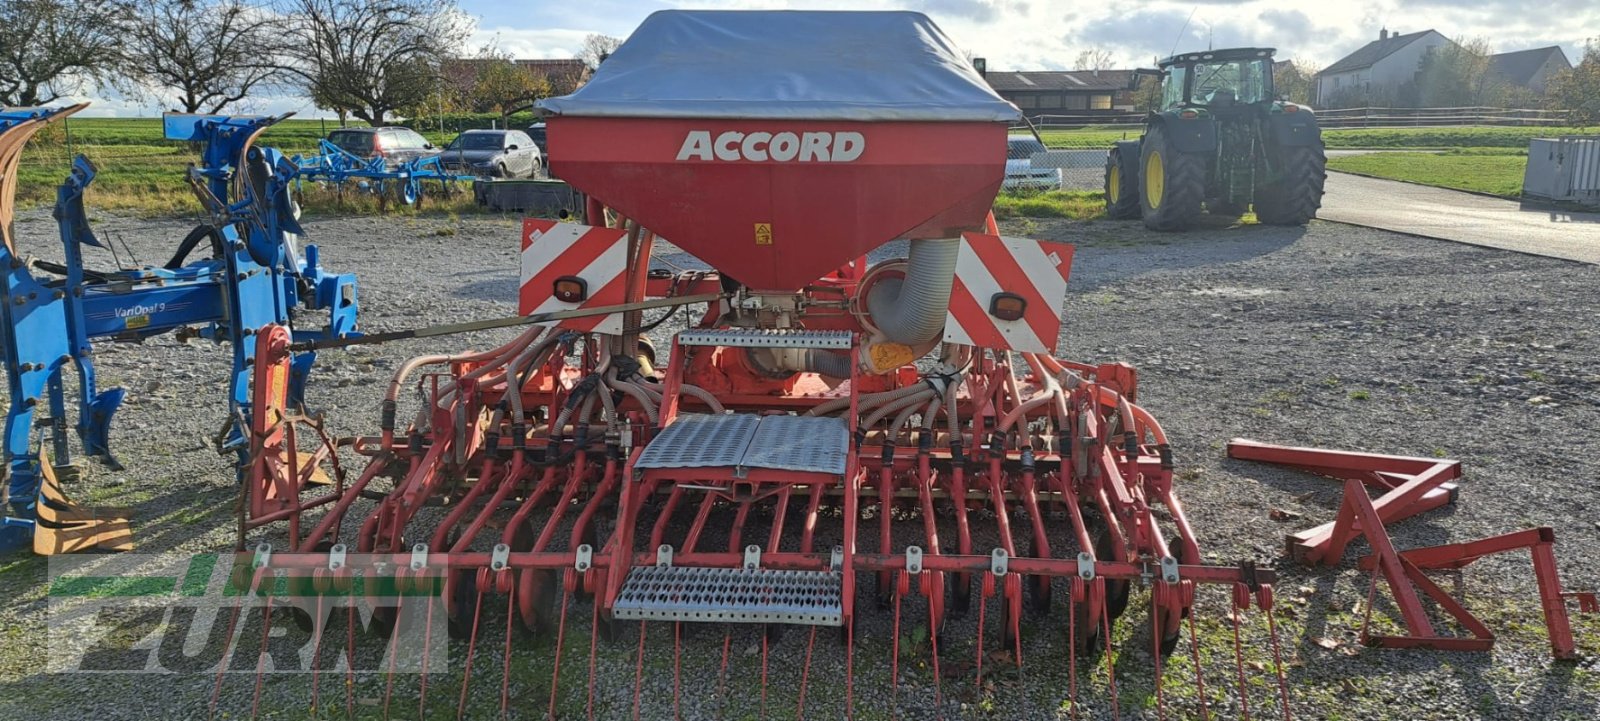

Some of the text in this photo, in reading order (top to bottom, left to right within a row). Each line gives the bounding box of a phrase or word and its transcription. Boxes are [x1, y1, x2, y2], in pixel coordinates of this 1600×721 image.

[676, 130, 865, 162] ACCORD
[114, 302, 166, 317] VariOpal 9
